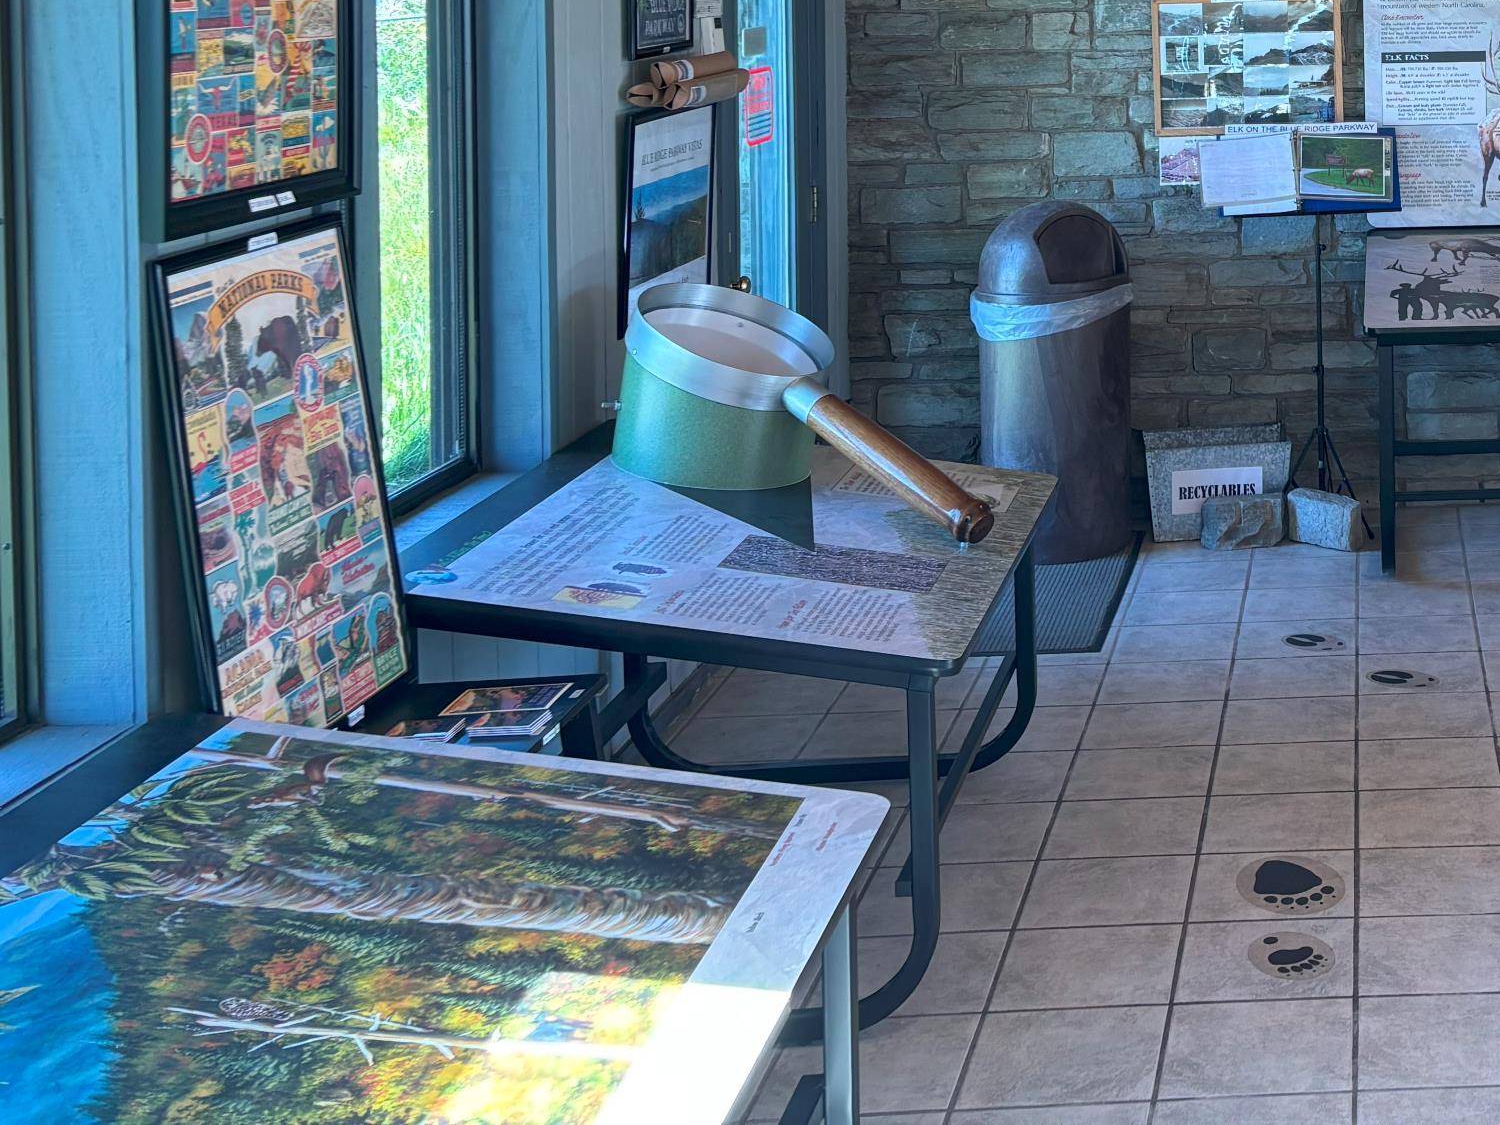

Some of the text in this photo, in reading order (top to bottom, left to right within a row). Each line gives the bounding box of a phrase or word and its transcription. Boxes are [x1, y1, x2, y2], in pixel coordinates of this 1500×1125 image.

[645, 18, 676, 36] PARKWAY
[655, 149, 668, 161] RIDGE
[669, 143, 687, 158] PARKWAY
[218, 273, 303, 318] NATIONAL PARKS
[1179, 483, 1256, 500] RECYCLABLES
